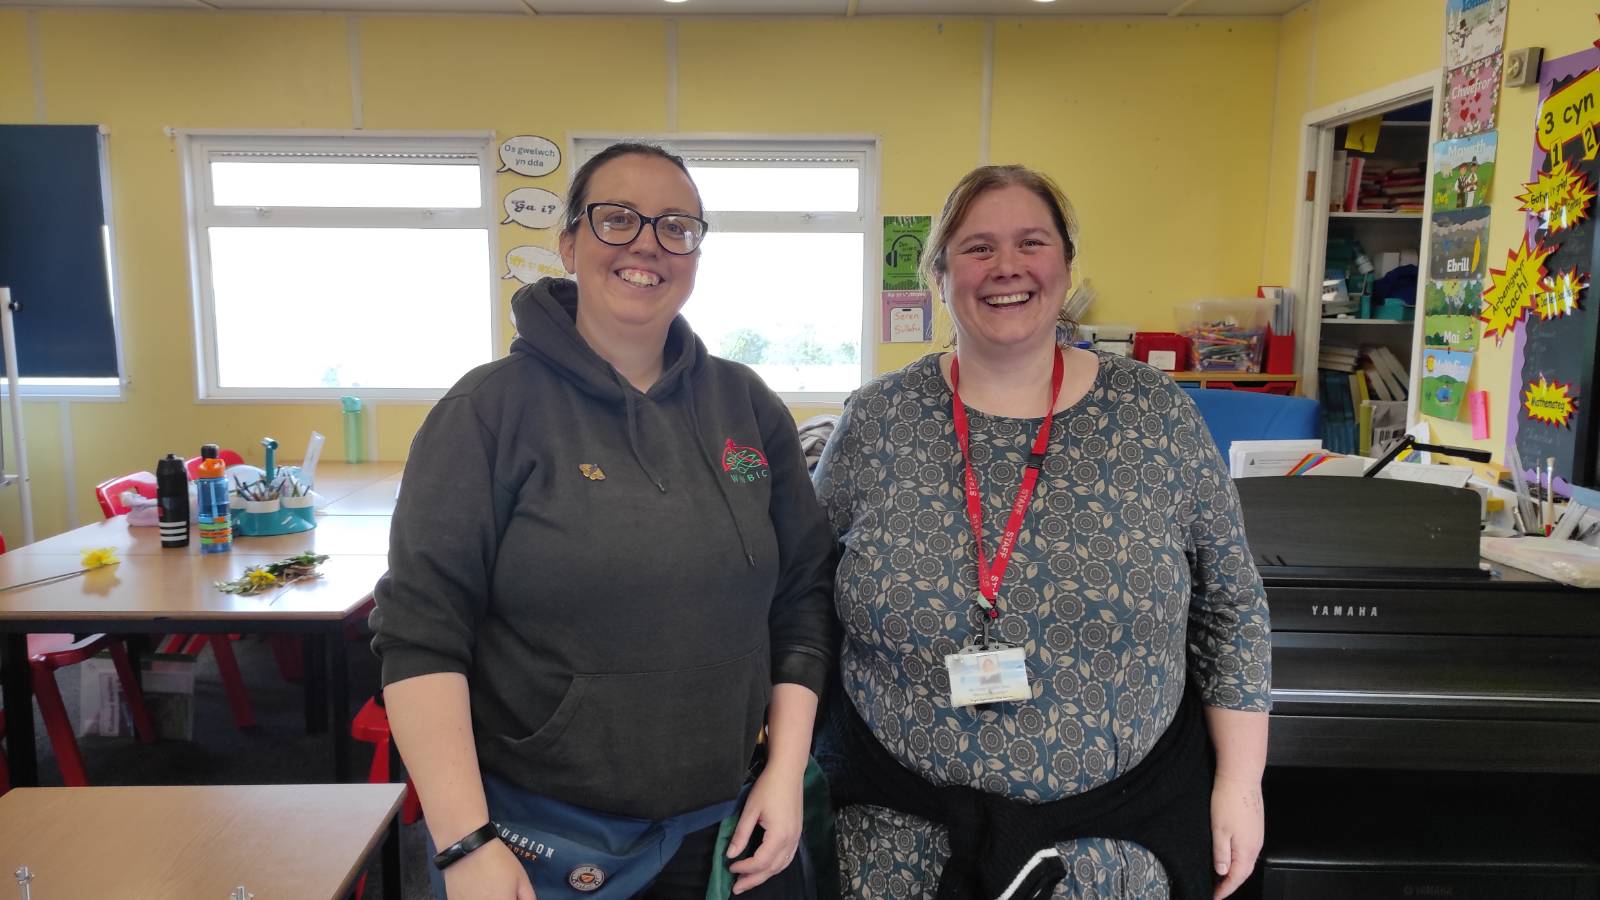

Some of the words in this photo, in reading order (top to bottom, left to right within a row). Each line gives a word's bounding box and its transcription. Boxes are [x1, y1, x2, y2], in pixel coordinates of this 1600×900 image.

[1544, 111, 1555, 134] 3
[1563, 92, 1594, 125] cyn
[504, 144, 516, 153] Os
[517, 147, 555, 157] gwelwch
[1584, 126, 1595, 152] 2
[527, 159, 544, 167] dda
[512, 200, 536, 213] Ga
[1446, 257, 1470, 273] Ebrill
[1492, 260, 1525, 315] Arbenigwyr
[1503, 274, 1529, 317] bach!
[1443, 331, 1460, 344] Mai
[1015, 488, 1029, 515] STAFF
[999, 531, 1015, 559] STAFF
[1311, 605, 1378, 617] YAMAHA
[496, 823, 555, 858] UBRION
